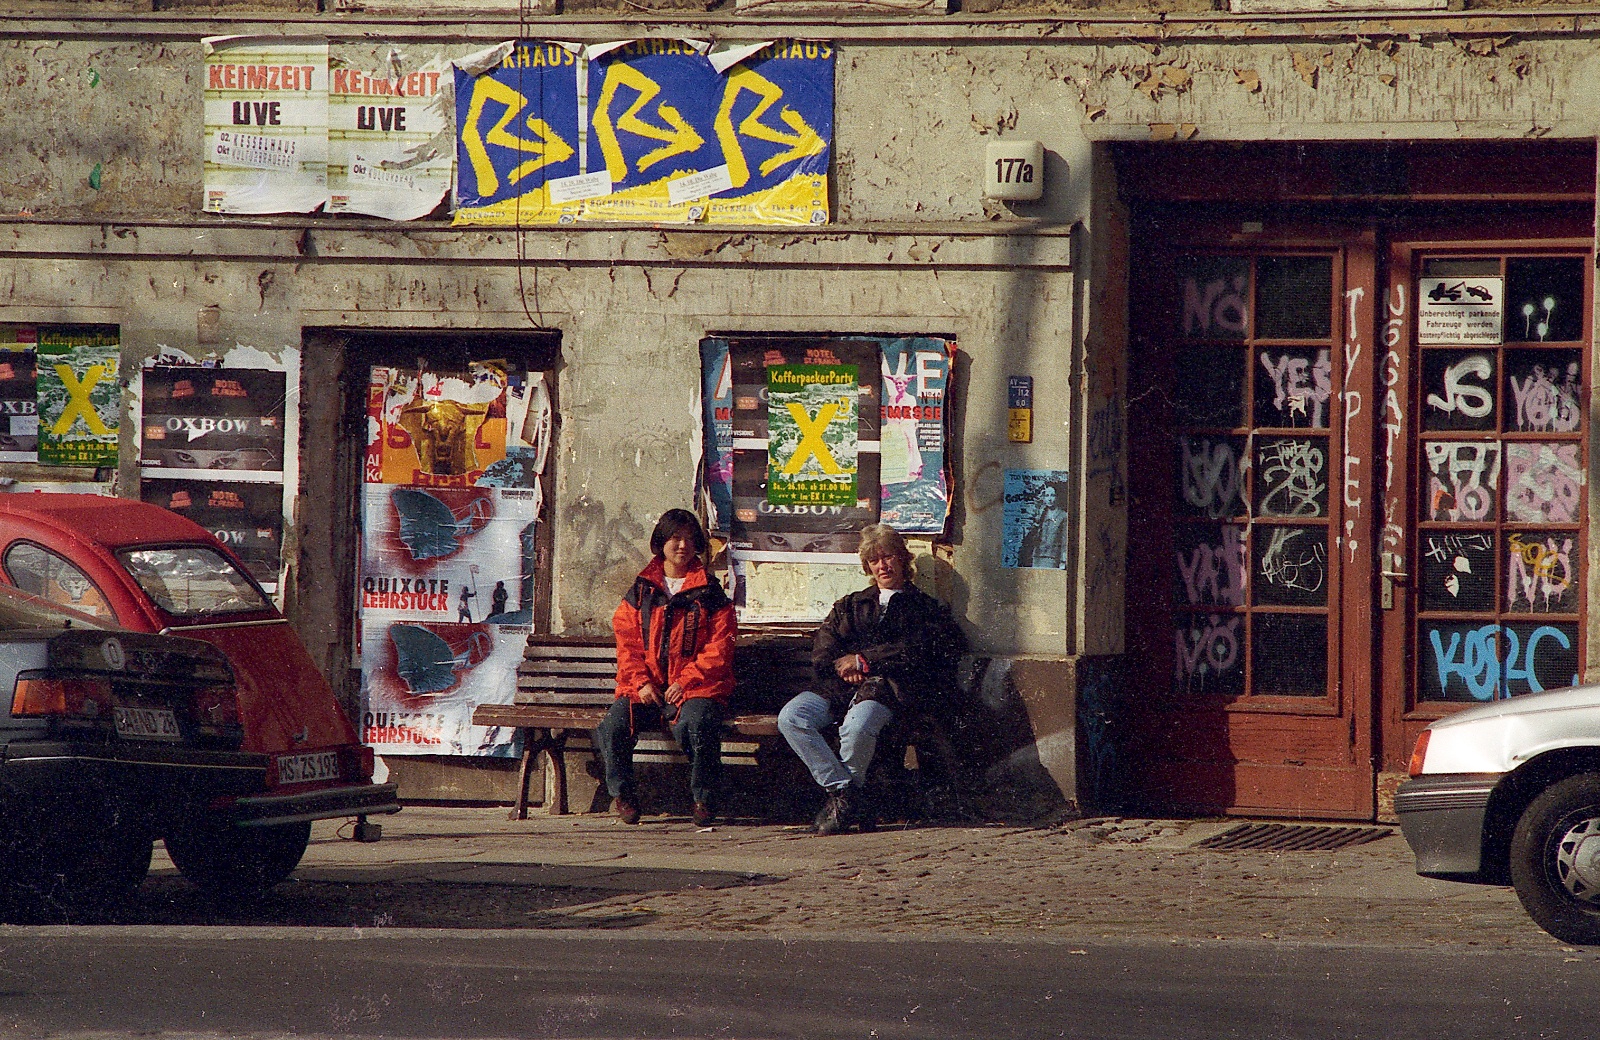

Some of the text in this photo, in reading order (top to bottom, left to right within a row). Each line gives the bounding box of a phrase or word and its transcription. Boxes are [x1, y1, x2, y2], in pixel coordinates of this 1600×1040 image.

[208, 65, 315, 91] KEIMZEIT
[232, 101, 281, 126] LIVE
[357, 106, 407, 132] LIVE
[994, 158, 1034, 184] 177a
[1420, 310, 1500, 318] Unberechtigt parkende
[1426, 320, 1462, 329] Fahrzeuge
[771, 371, 853, 386] KofferpackerParty
[166, 417, 249, 434] OXBOW
[840, 482, 852, 490] Uhr
[811, 492, 820, 500] EX
[363, 577, 449, 595] QUIXOTE
